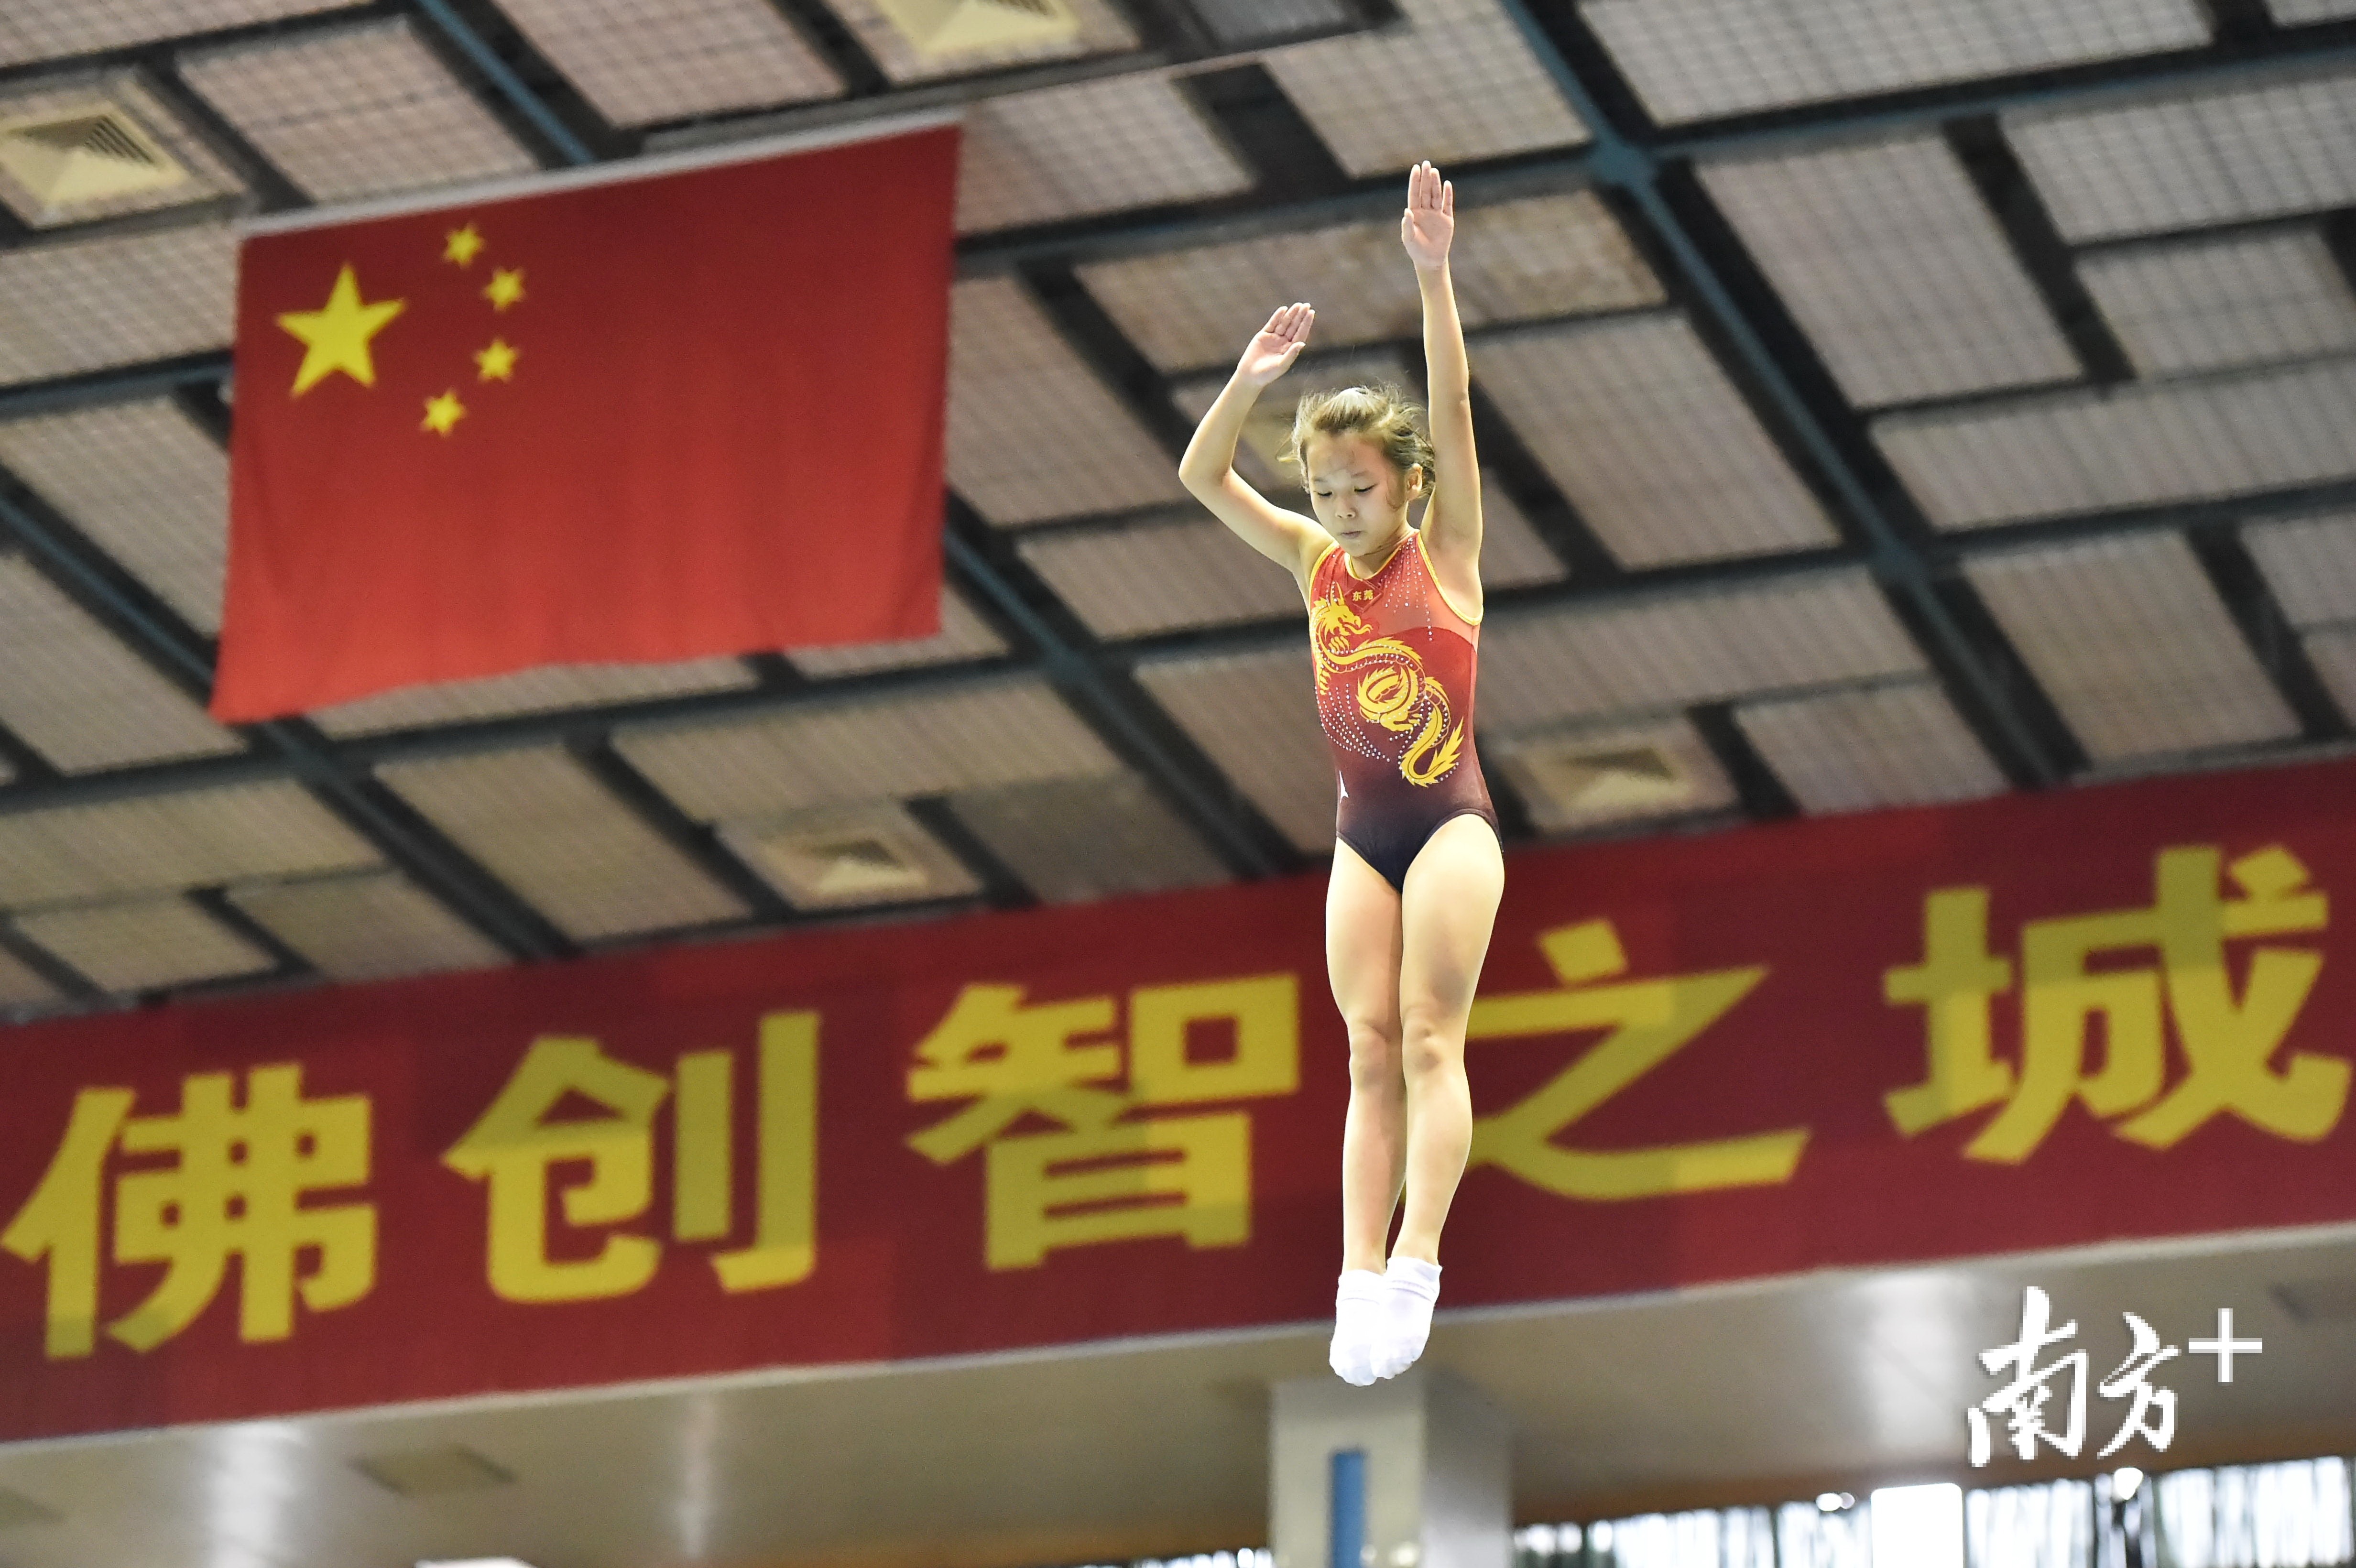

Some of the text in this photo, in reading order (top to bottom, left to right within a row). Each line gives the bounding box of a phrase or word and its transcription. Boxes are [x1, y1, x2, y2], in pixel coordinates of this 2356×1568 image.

[1352, 589, 1374, 601] 东莞
[1, 845, 2352, 1359] 佛创智之城
